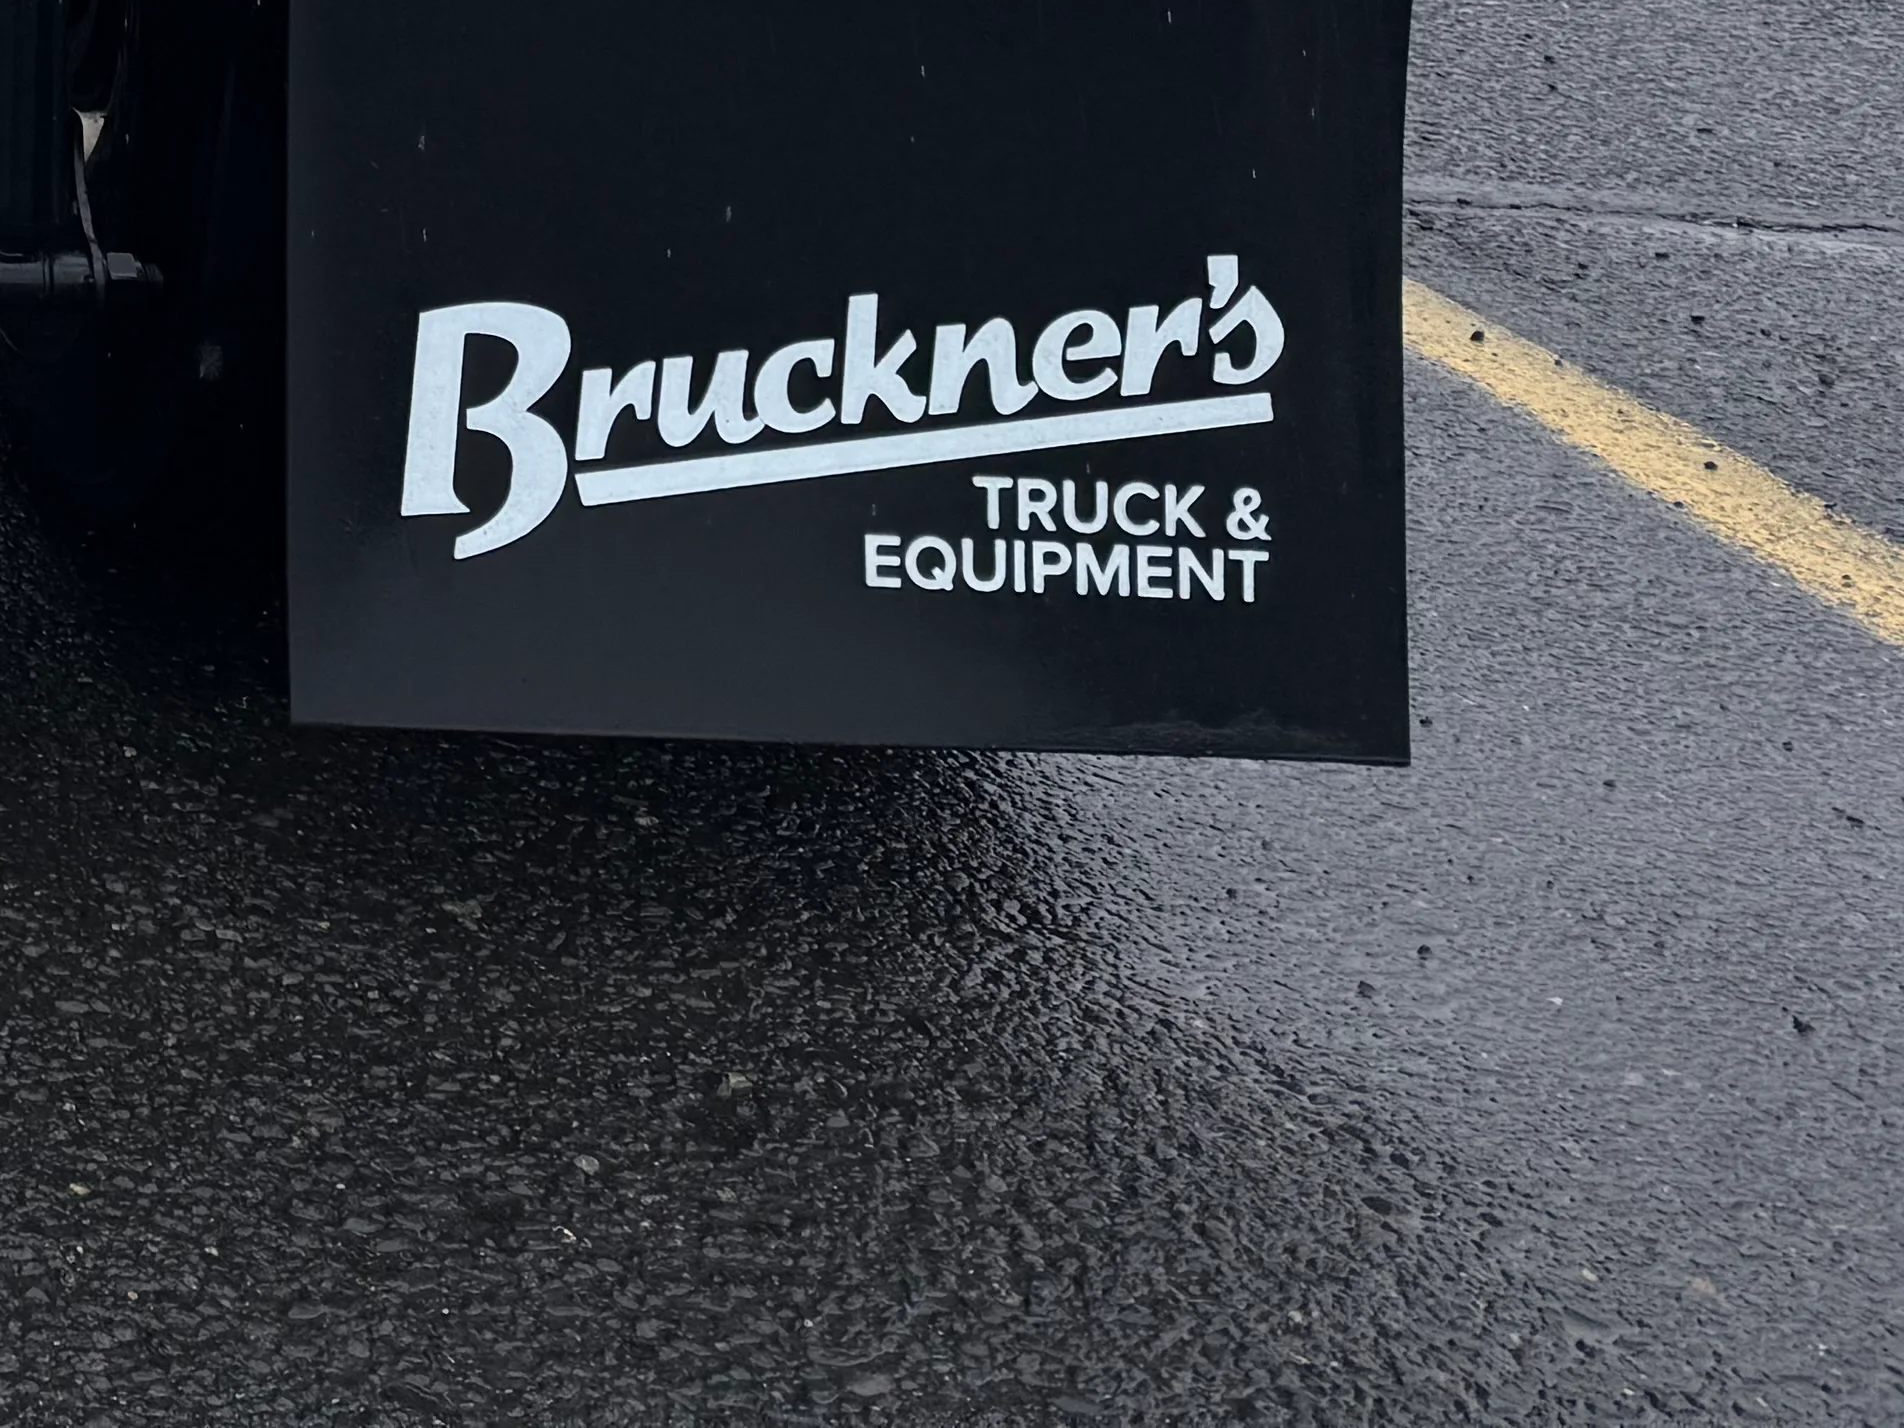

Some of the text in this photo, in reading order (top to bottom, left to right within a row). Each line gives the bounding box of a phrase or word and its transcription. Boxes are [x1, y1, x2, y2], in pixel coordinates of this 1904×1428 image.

[400, 254, 1285, 560] Bruckner's
[971, 475, 1272, 541] TRUCK &
[864, 533, 1270, 603] EQUIPMENT
